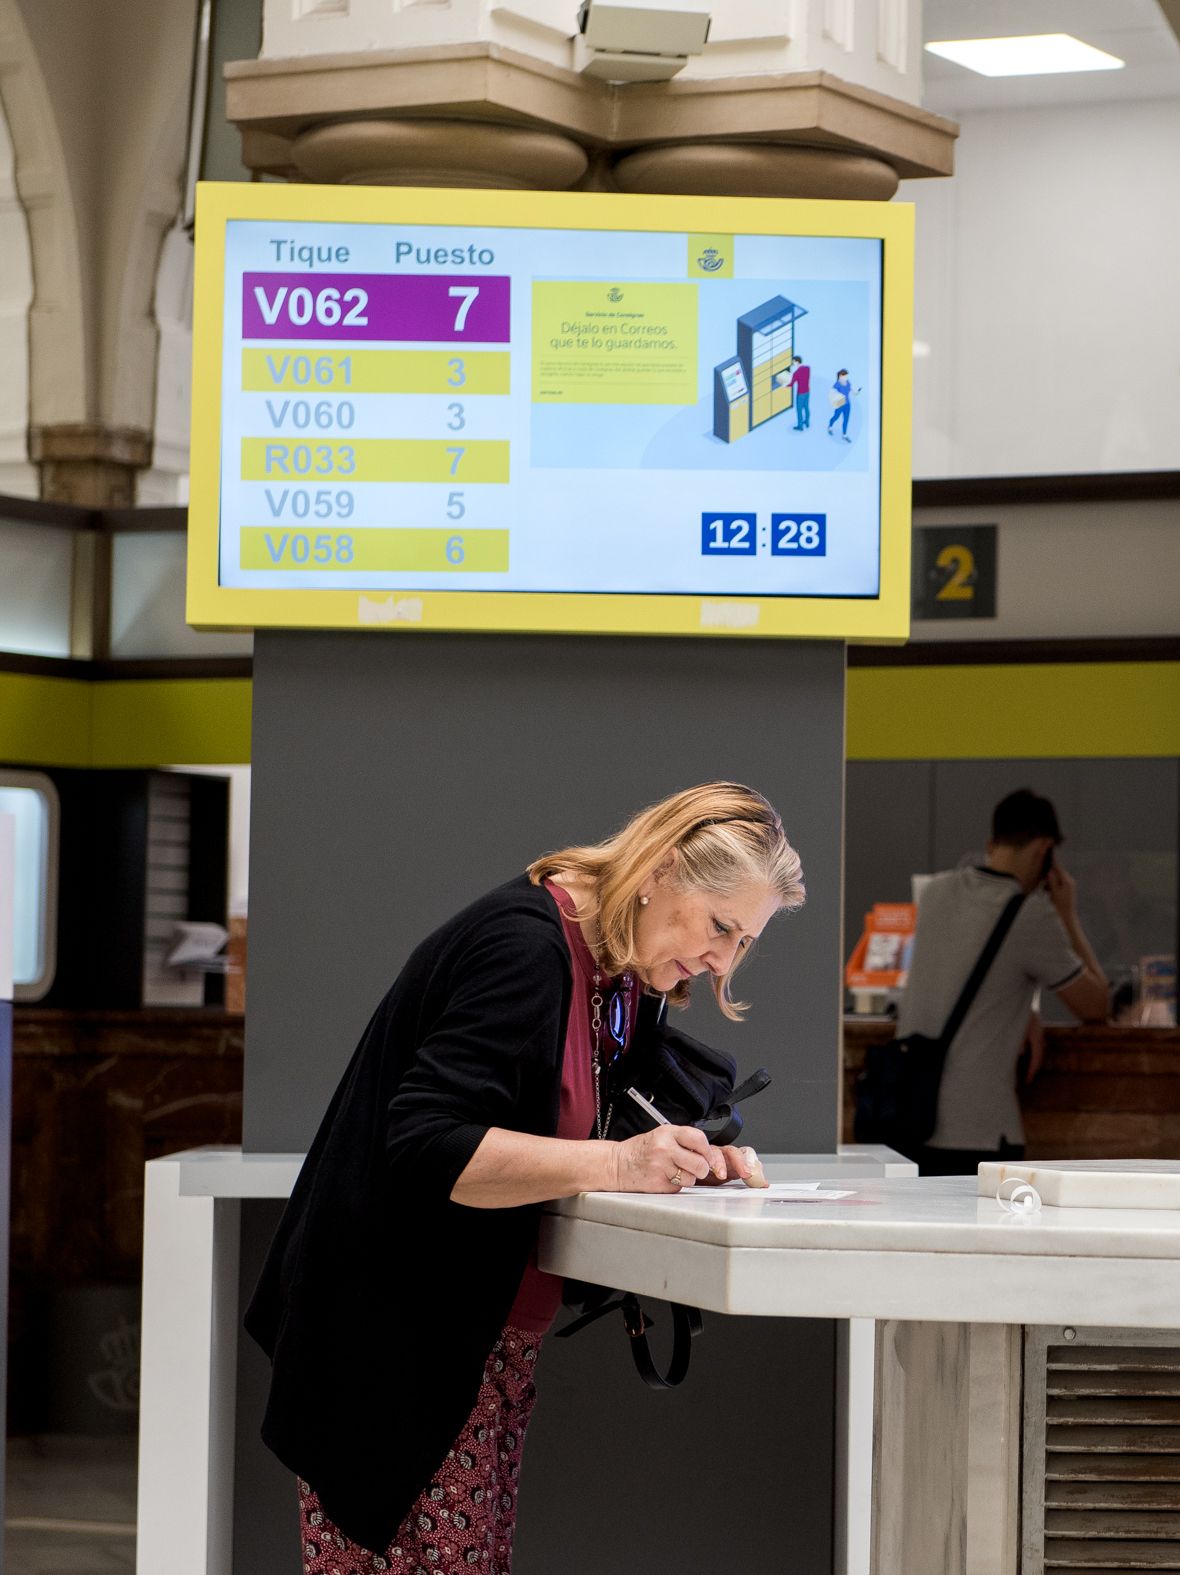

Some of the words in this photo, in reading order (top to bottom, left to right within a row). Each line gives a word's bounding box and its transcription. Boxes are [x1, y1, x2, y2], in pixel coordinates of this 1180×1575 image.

[270, 239, 351, 268] Tique
[394, 241, 495, 266] Puesto
[254, 286, 369, 327] V062
[448, 286, 480, 332] 7
[550, 339, 573, 350] que
[577, 337, 589, 348] te
[591, 337, 603, 348] lo
[605, 337, 678, 352] guardamos.
[561, 322, 599, 337] Déjalo
[602, 325, 617, 335] en
[620, 322, 668, 336] Correos
[265, 355, 353, 386] V061
[447, 357, 466, 387] 3
[265, 399, 355, 429] V060
[446, 402, 466, 431] 3
[264, 444, 356, 475] R033
[446, 447, 466, 476] 7
[264, 489, 355, 519] V059
[446, 492, 466, 520] 5
[264, 533, 354, 564] V058
[445, 535, 465, 565] 6
[936, 544, 975, 601] 2
